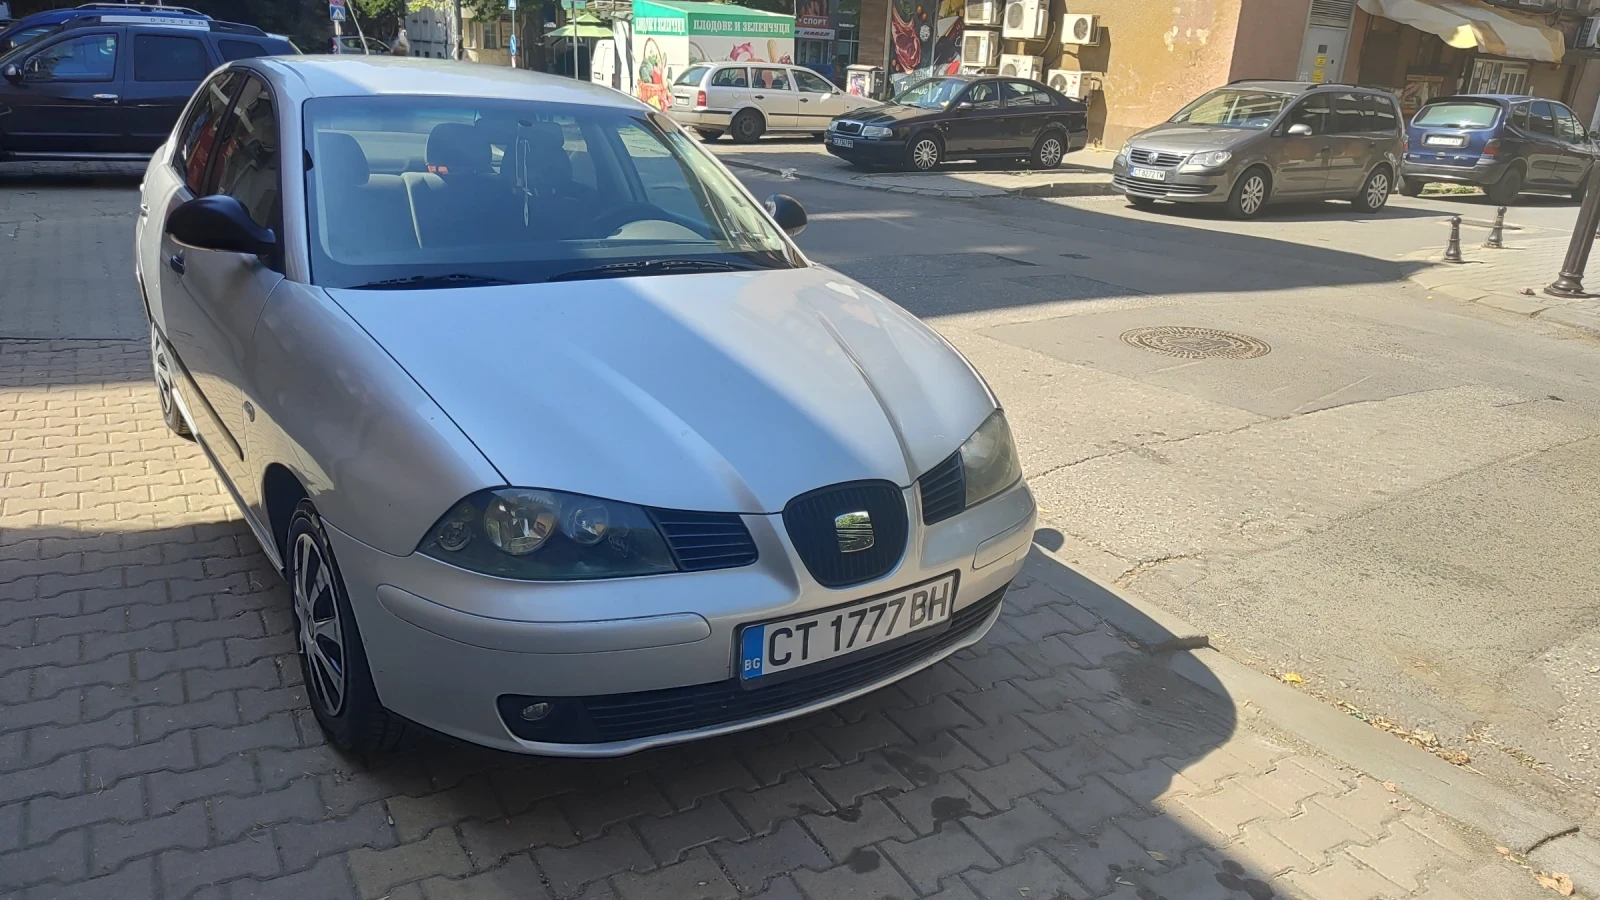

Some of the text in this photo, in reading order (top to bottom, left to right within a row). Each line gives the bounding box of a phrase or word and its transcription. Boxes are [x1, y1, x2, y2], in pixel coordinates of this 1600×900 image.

[693, 19, 733, 32] ПЛОДОВЕ
[734, 21, 741, 31] И
[742, 22, 790, 35] ЗЕЛЕНЧУЦИ
[803, 17, 827, 25] СПОРТ
[1142, 169, 1156, 178] 8272
[768, 582, 949, 667] CT 1777 BH
[744, 657, 761, 671] BG
